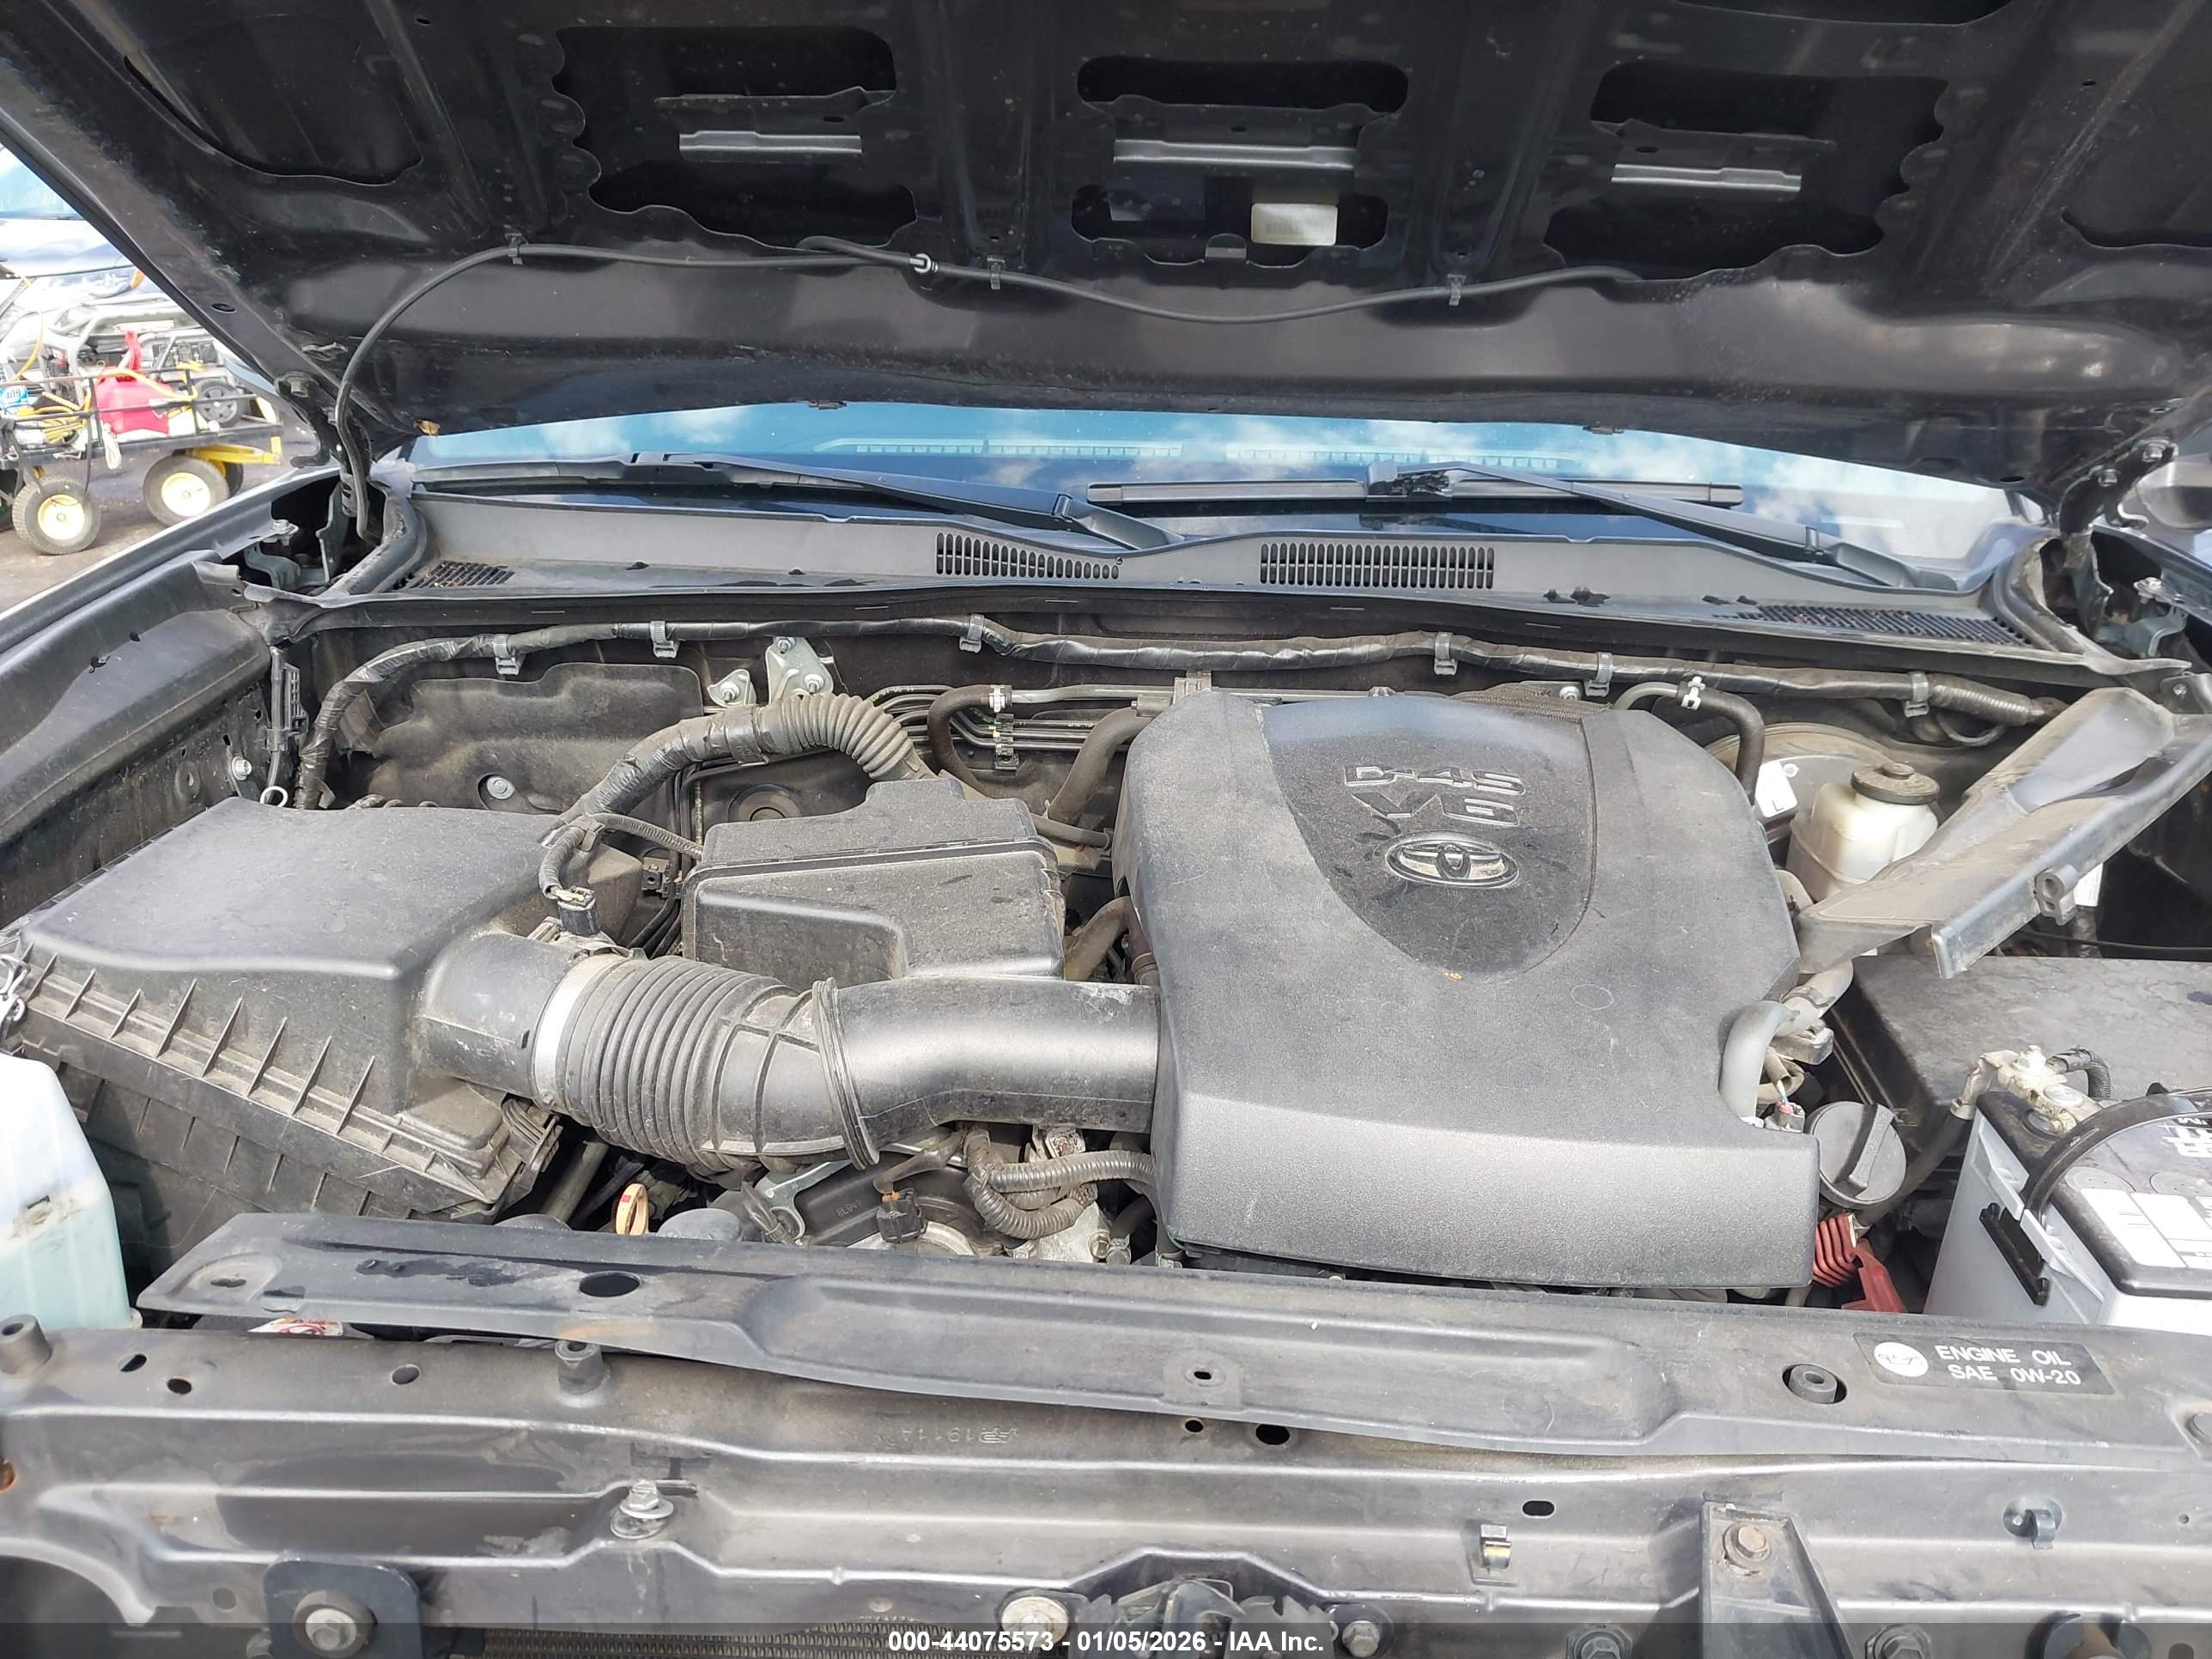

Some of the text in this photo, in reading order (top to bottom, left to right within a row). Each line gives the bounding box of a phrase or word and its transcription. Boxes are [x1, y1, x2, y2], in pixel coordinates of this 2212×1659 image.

[1343, 764, 1525, 796] D-4S
[1347, 790, 1520, 827] V6
[1934, 1345, 2072, 1366] ENGINE OIL
[1947, 1364, 2082, 1386] SAE 0W-20
